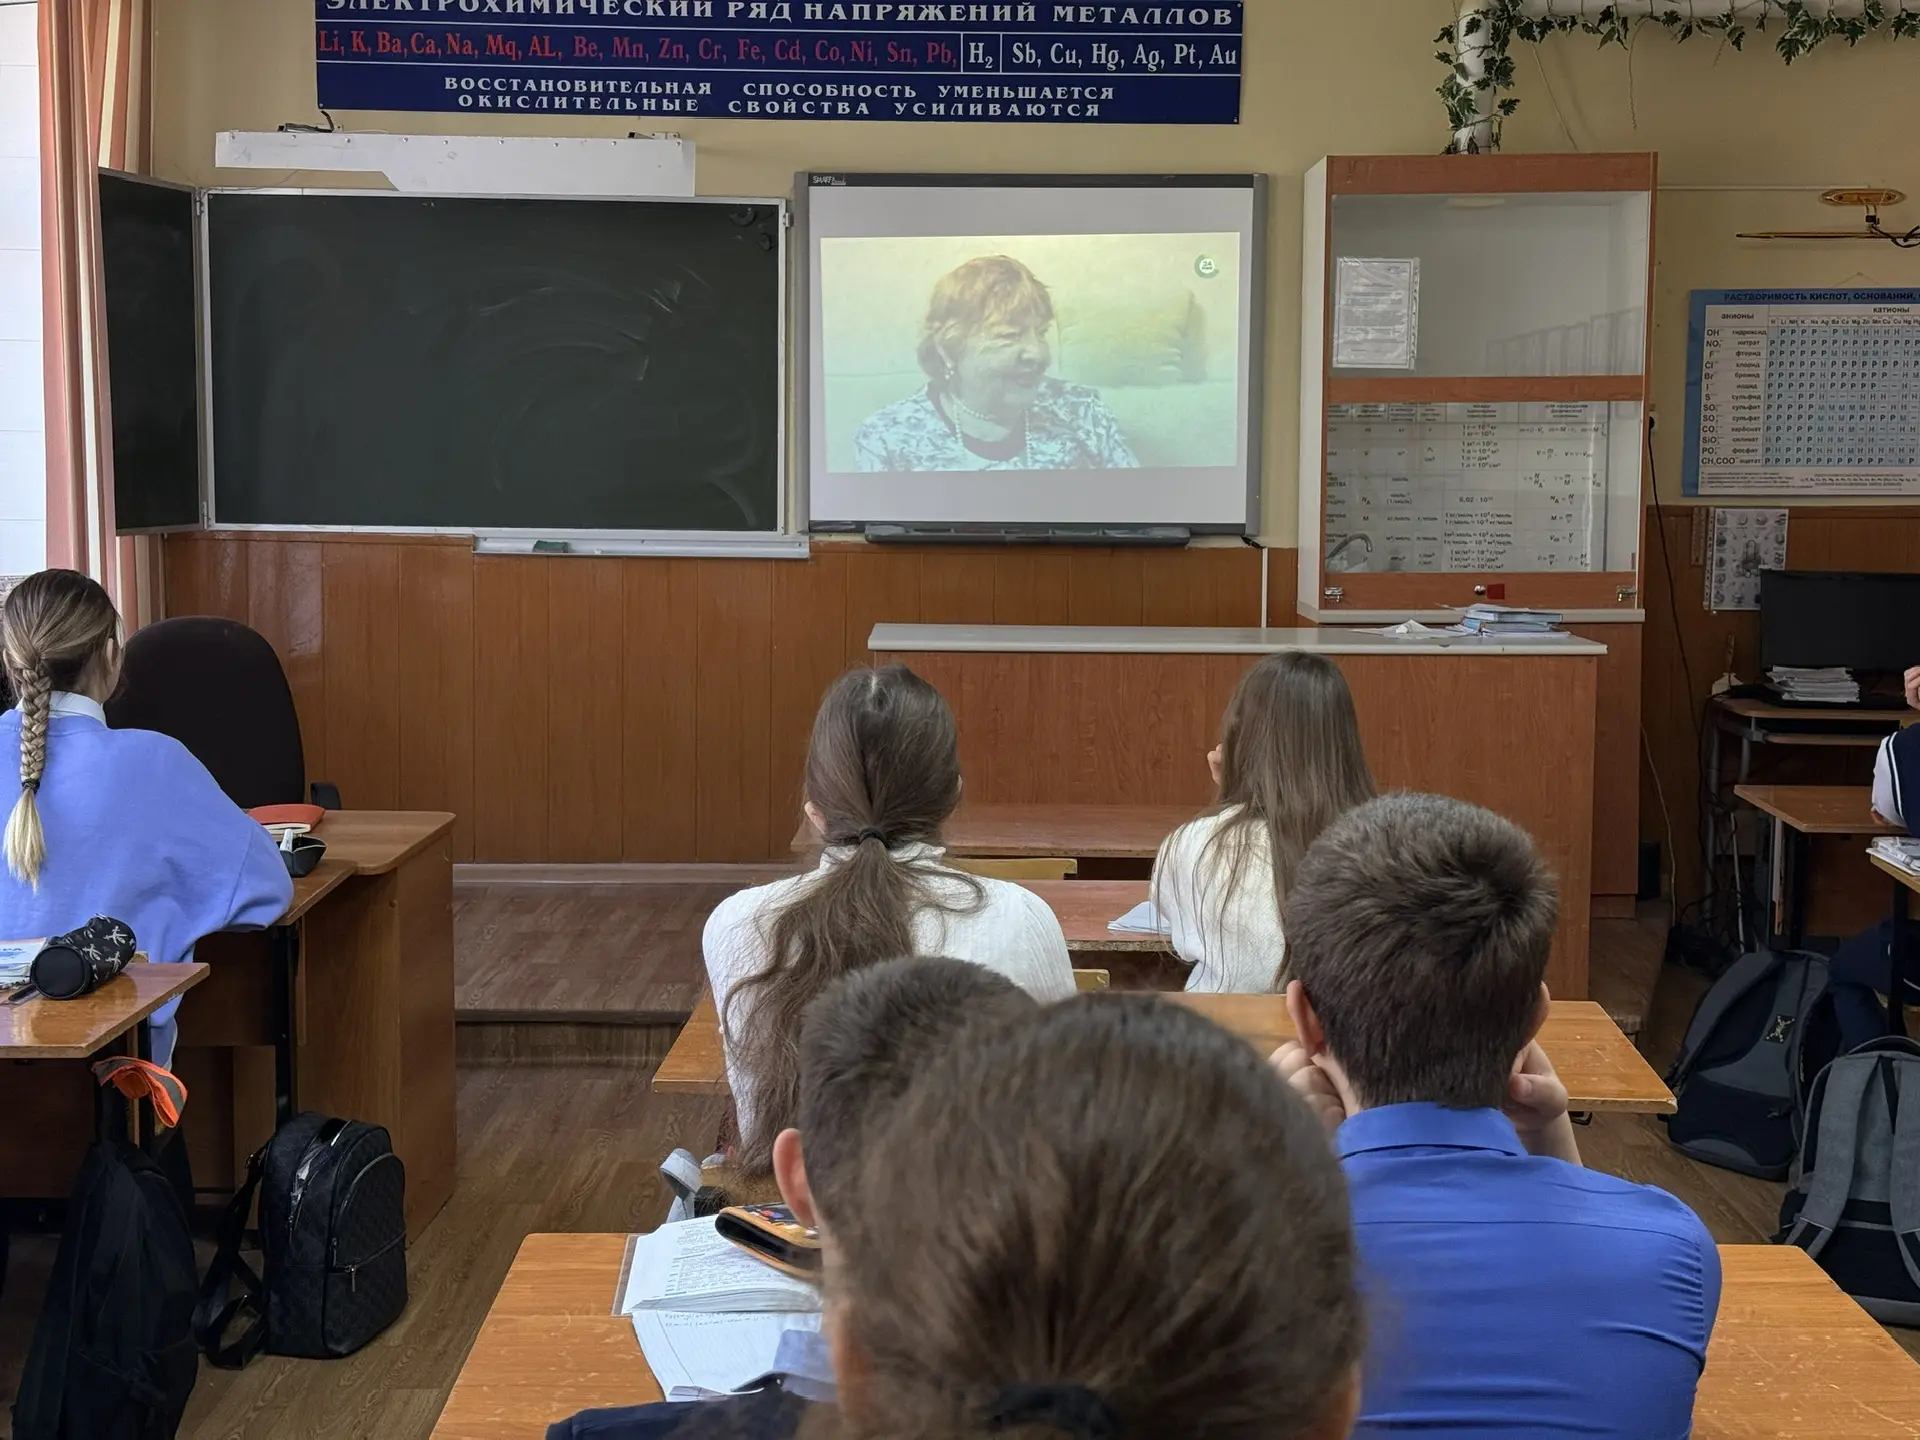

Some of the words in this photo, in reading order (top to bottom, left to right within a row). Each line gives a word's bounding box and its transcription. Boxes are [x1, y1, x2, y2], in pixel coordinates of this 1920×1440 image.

[728, 0, 792, 23] РЯД
[804, 2, 1036, 22] НАПРЯЖЕНИЙ
[1053, 5, 1233, 26] МЕТАЛЛОВ
[319, 30, 345, 56] Li,
[351, 30, 372, 57] K,
[377, 31, 408, 58] Ba,
[410, 32, 442, 58] Ca,
[446, 32, 479, 59] Na,
[573, 36, 604, 62] Be,
[612, 36, 650, 62] Mn,
[658, 37, 690, 63] Zn,
[699, 38, 727, 63] Cr,
[738, 38, 766, 64] Fe,
[775, 39, 807, 65] Cd,
[815, 40, 846, 66] Co,
[851, 40, 878, 67] Ni,
[887, 41, 918, 68] Sn,
[926, 42, 958, 68] Pb,
[1012, 42, 1042, 68] Sb,
[1050, 43, 1083, 69] Cu,
[1091, 43, 1126, 71] Hg,
[1133, 43, 1166, 71] Ag,
[1174, 43, 1203, 69] Pt,
[1209, 43, 1237, 65] Au
[445, 77, 712, 95] ВОССТАНОВИТЕЛЬНАЯ
[743, 83, 917, 99] СПОСОБНОСТЬ
[938, 85, 1114, 100] УМЕНЬШАЕТСЯ
[458, 94, 699, 111] ОКИСЛИТЕЛЬНЫЕ
[728, 99, 869, 115] СВОЙСТВА
[894, 102, 1100, 117] УСИЛИВАЮТСЯ
